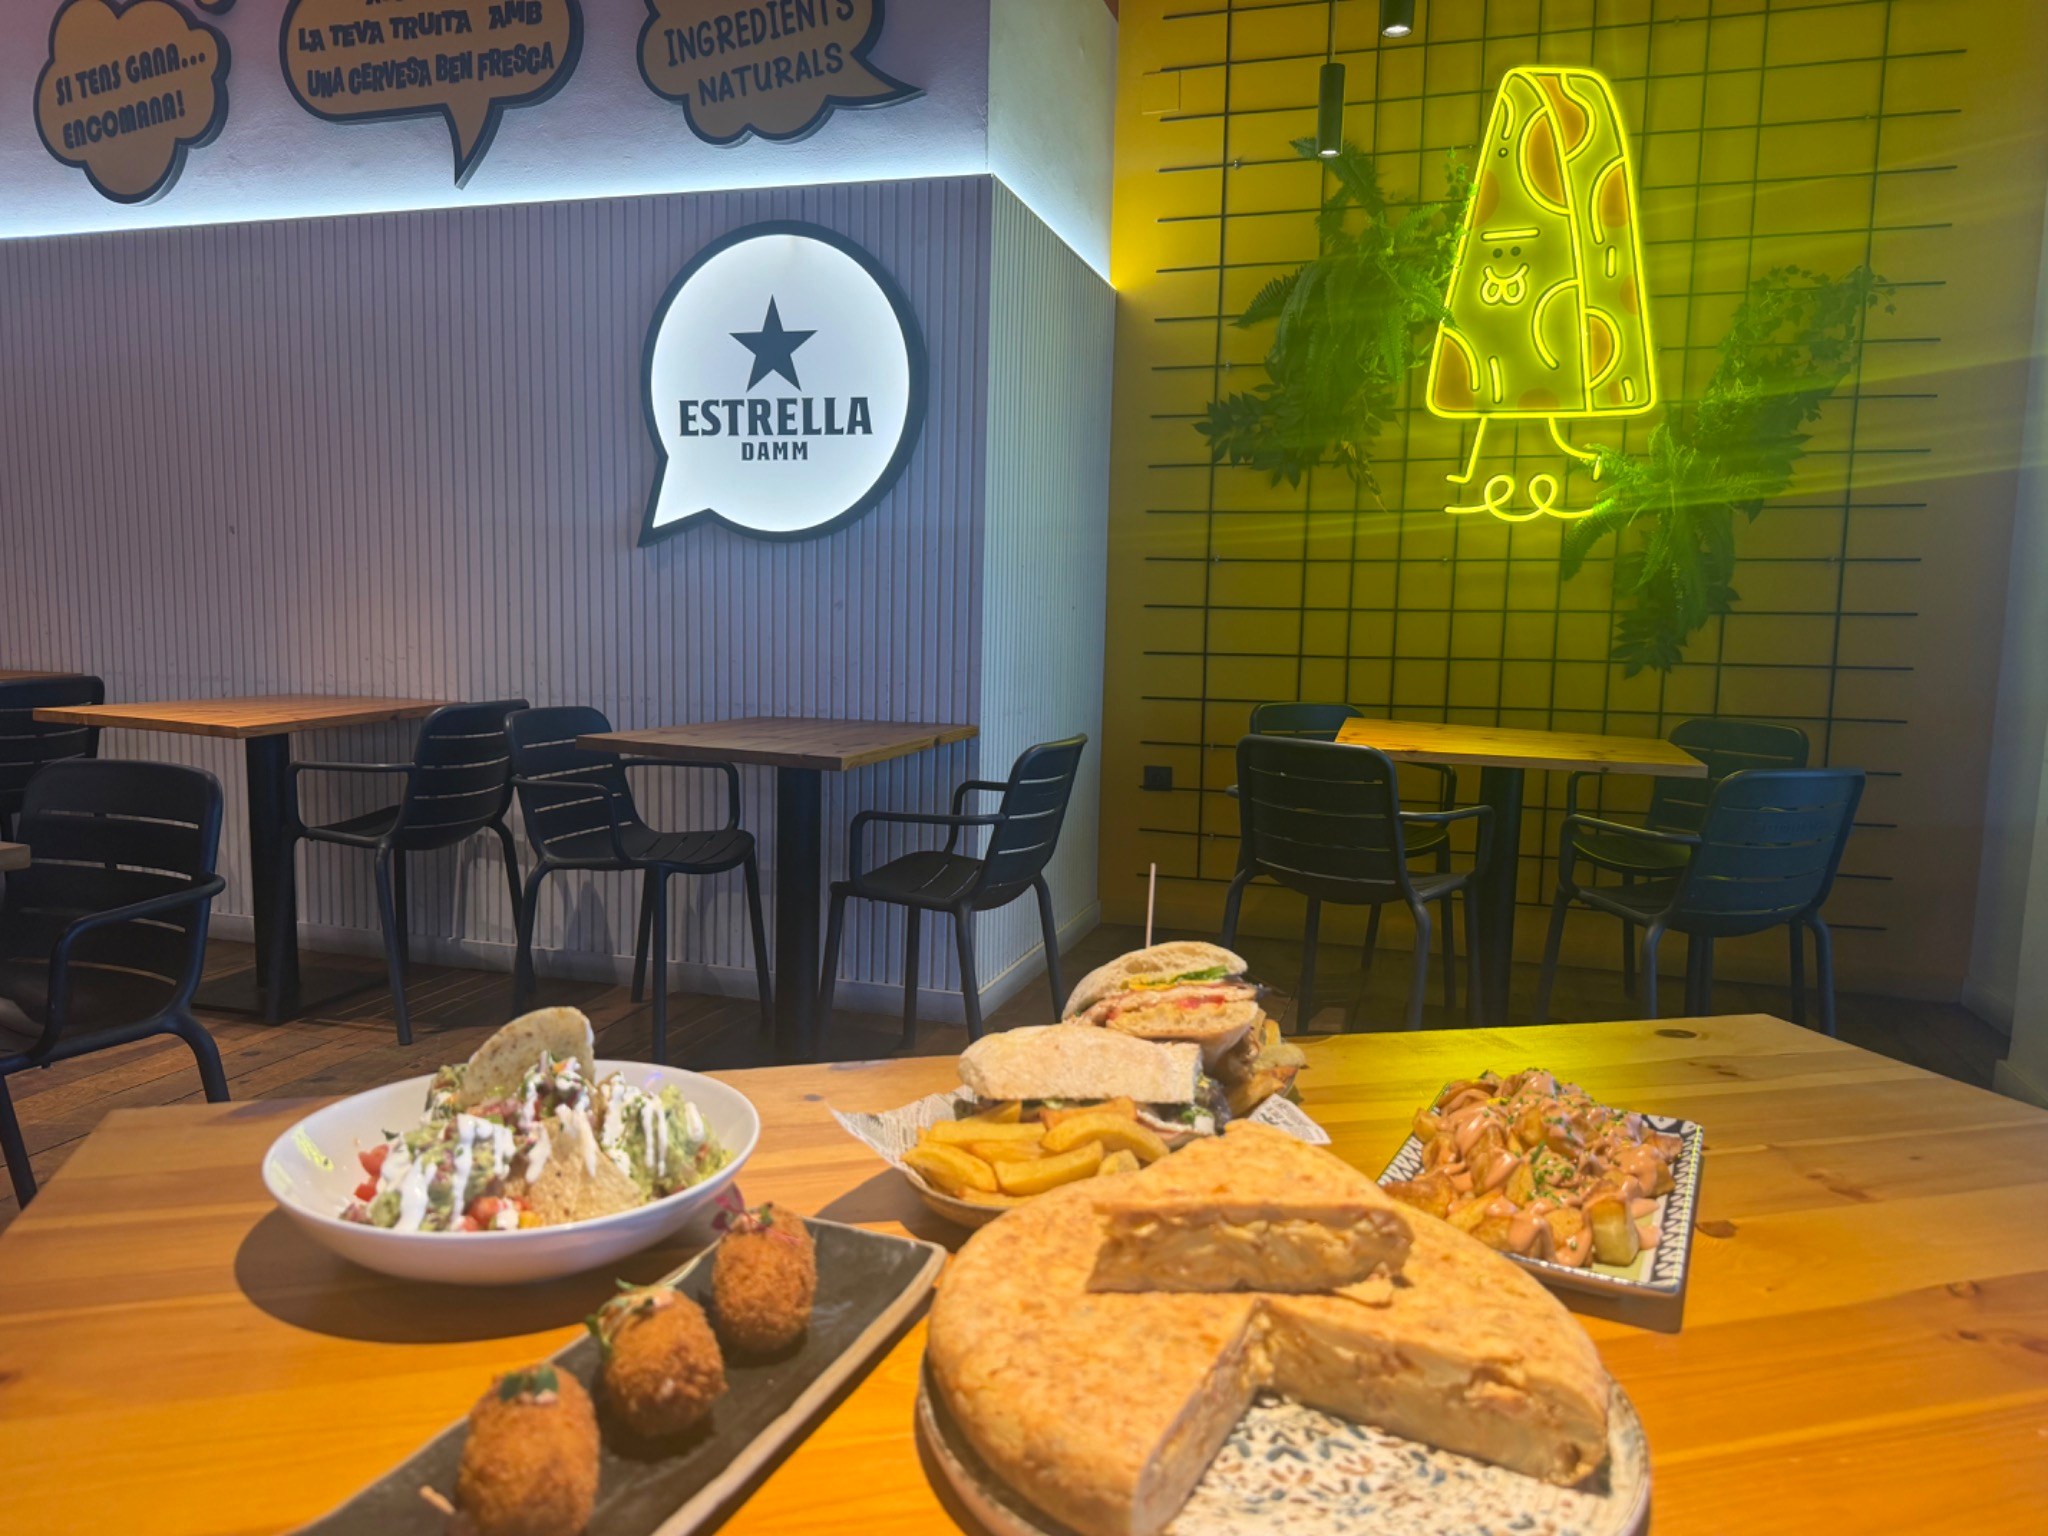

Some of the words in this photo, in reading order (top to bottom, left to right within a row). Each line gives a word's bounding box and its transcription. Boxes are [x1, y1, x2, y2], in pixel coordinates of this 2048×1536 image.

[298, 27, 326, 52] LA
[329, 20, 385, 48] TEVA
[389, 10, 473, 40] TRUITA
[488, 0, 543, 30] AMB
[664, 0, 854, 67] INGREDIENTS
[56, 76, 73, 106] SI
[75, 60, 121, 98] TENS
[125, 43, 206, 84] GANA...
[307, 66, 345, 98] UNA
[348, 56, 433, 95] CERVESA
[435, 51, 473, 84] BEN
[478, 41, 555, 81] FRESCA
[698, 42, 844, 107] NATURALS
[63, 89, 186, 149] ENCOMANA!
[679, 396, 873, 437] ESTRELLA
[741, 441, 808, 461] DAMM
